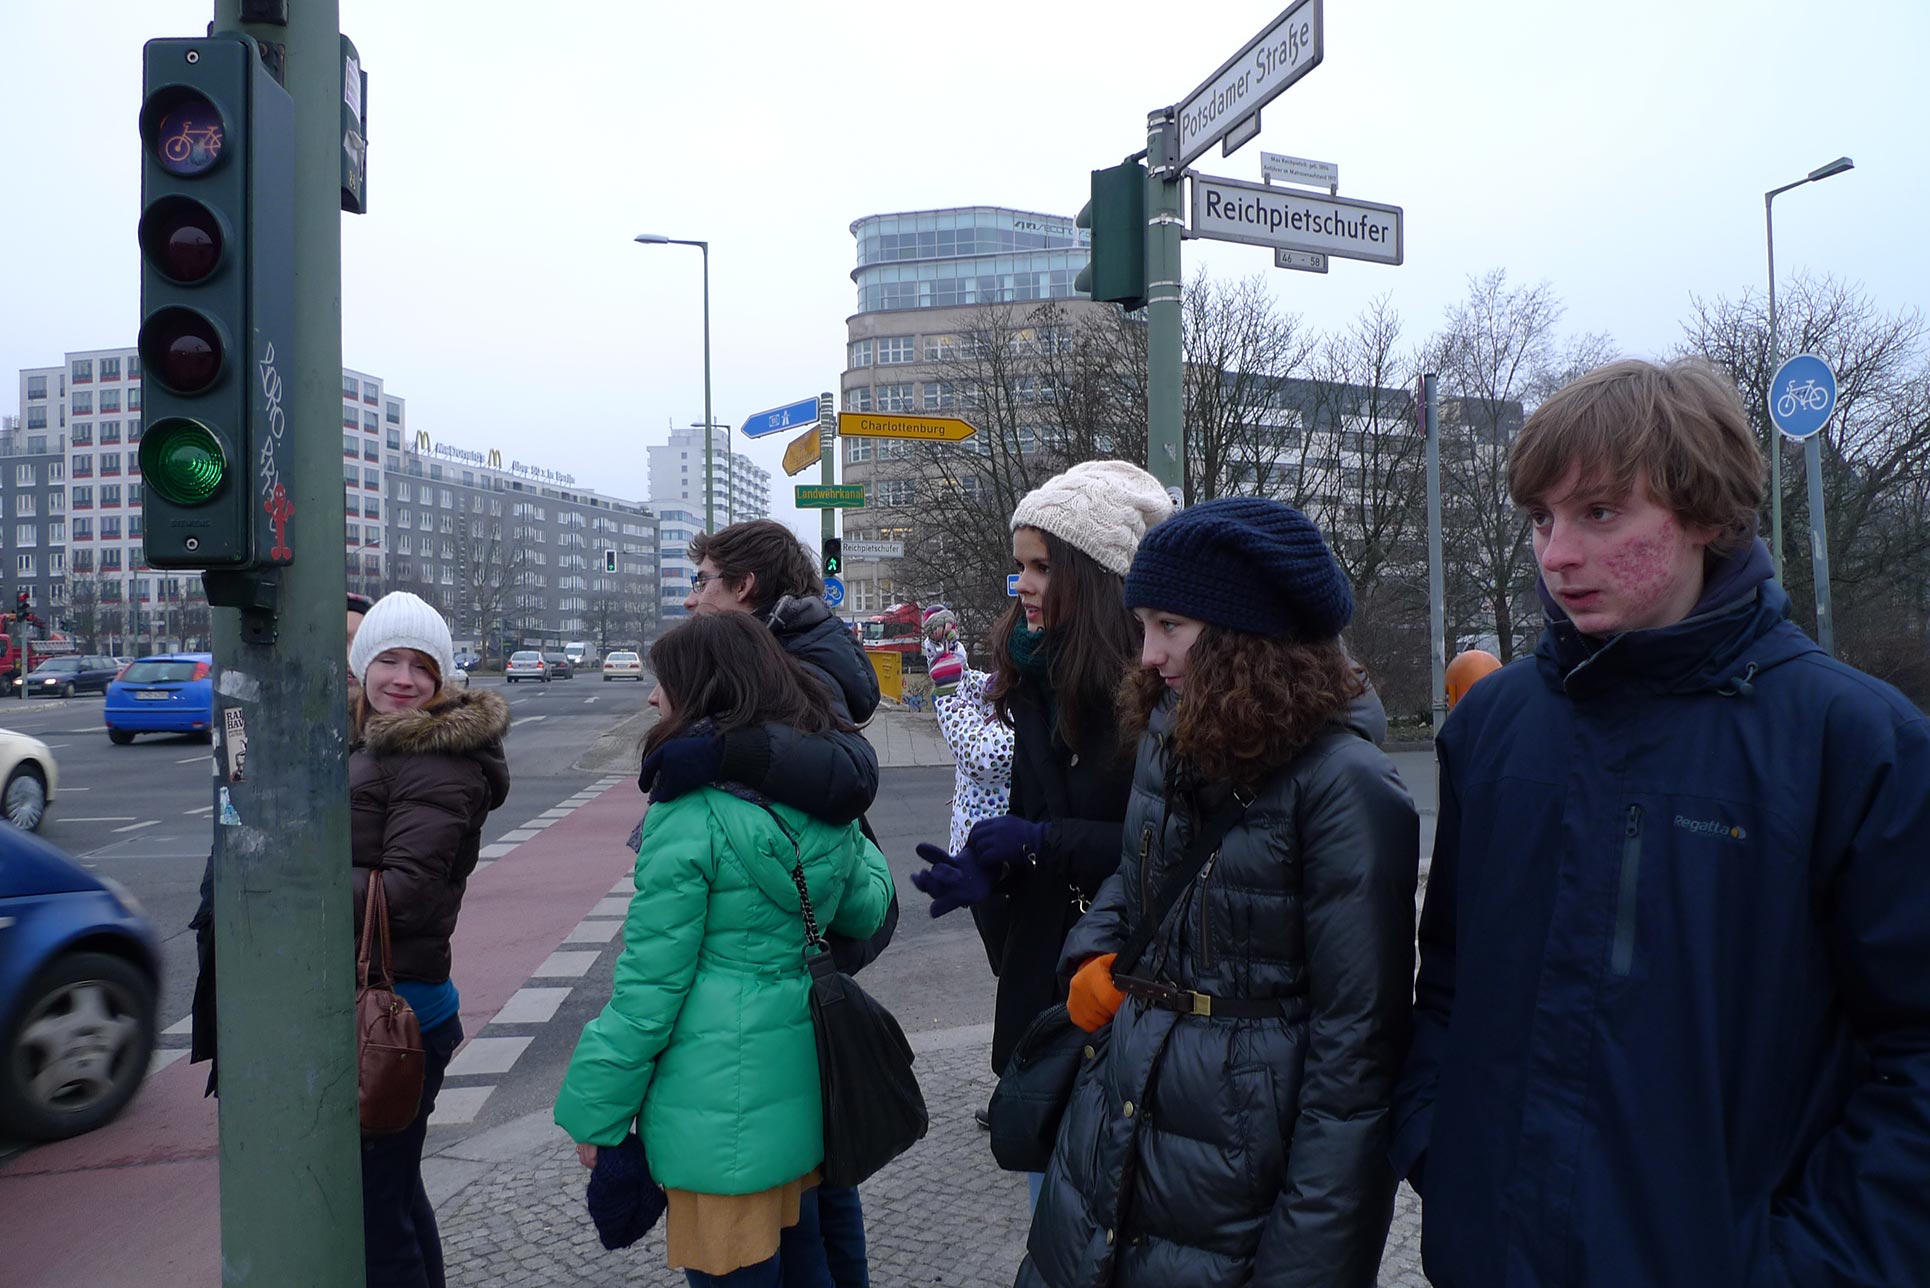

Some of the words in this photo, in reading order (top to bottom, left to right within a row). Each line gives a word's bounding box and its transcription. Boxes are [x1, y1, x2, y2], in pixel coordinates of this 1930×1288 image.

[1182, 70, 1251, 145] Potsdamer
[1256, 21, 1309, 84] Straße
[1206, 189, 1389, 244] Reichpietschufer
[1281, 253, 1292, 264] 46
[1310, 256, 1321, 267] 58
[860, 419, 946, 436] Charlottenburg
[796, 487, 865, 500] Landwehrkanal
[842, 543, 900, 553] Reichpietschufer
[1673, 814, 1731, 835] Regatta
